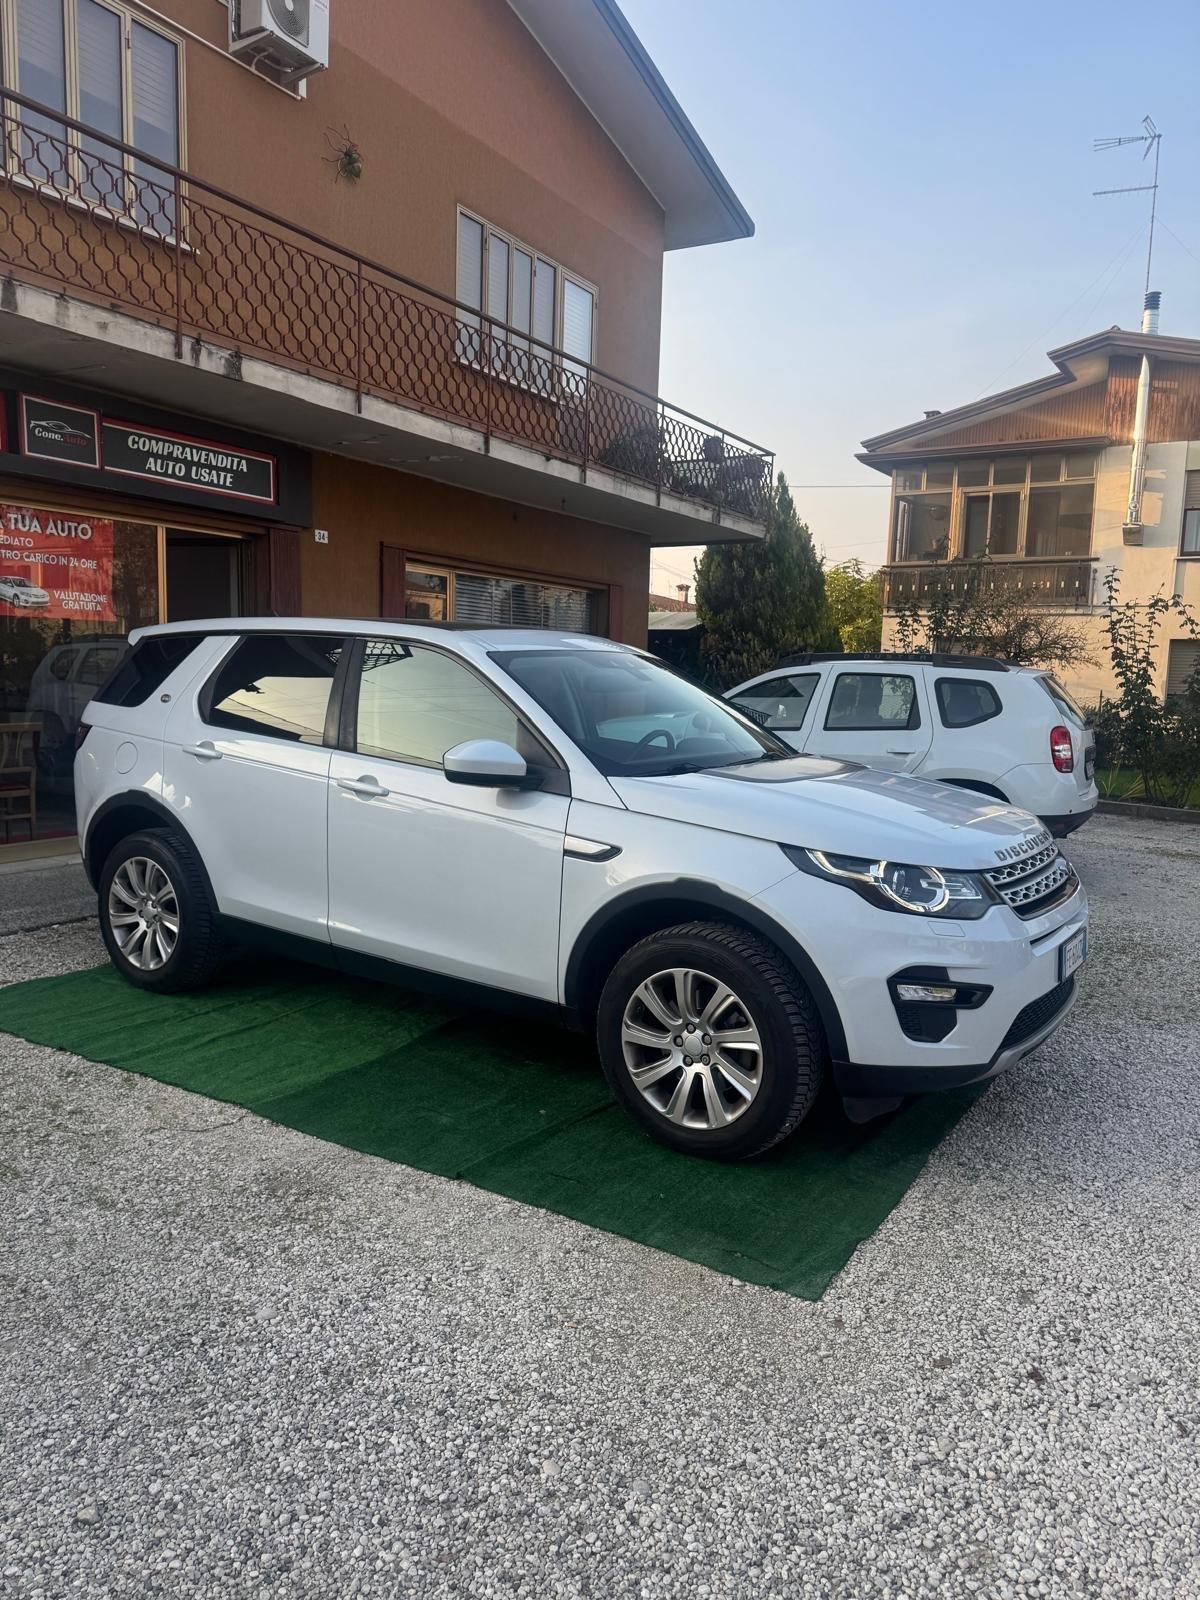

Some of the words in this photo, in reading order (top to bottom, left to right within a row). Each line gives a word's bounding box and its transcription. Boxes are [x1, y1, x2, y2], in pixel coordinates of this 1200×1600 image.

[127, 435, 248, 472] COMPRAVENDITA
[145, 457, 186, 477] AUTO
[191, 466, 234, 487] USATE
[7, 513, 43, 534] TUA
[46, 520, 92, 540] AUTO
[23, 552, 57, 564] CARICO
[59, 556, 68, 566] IN
[70, 557, 79, 567] 24
[80, 559, 97, 569] ORE
[53, 590, 108, 603] VALUTAZIONE
[62, 600, 102, 611] GRATUITA
